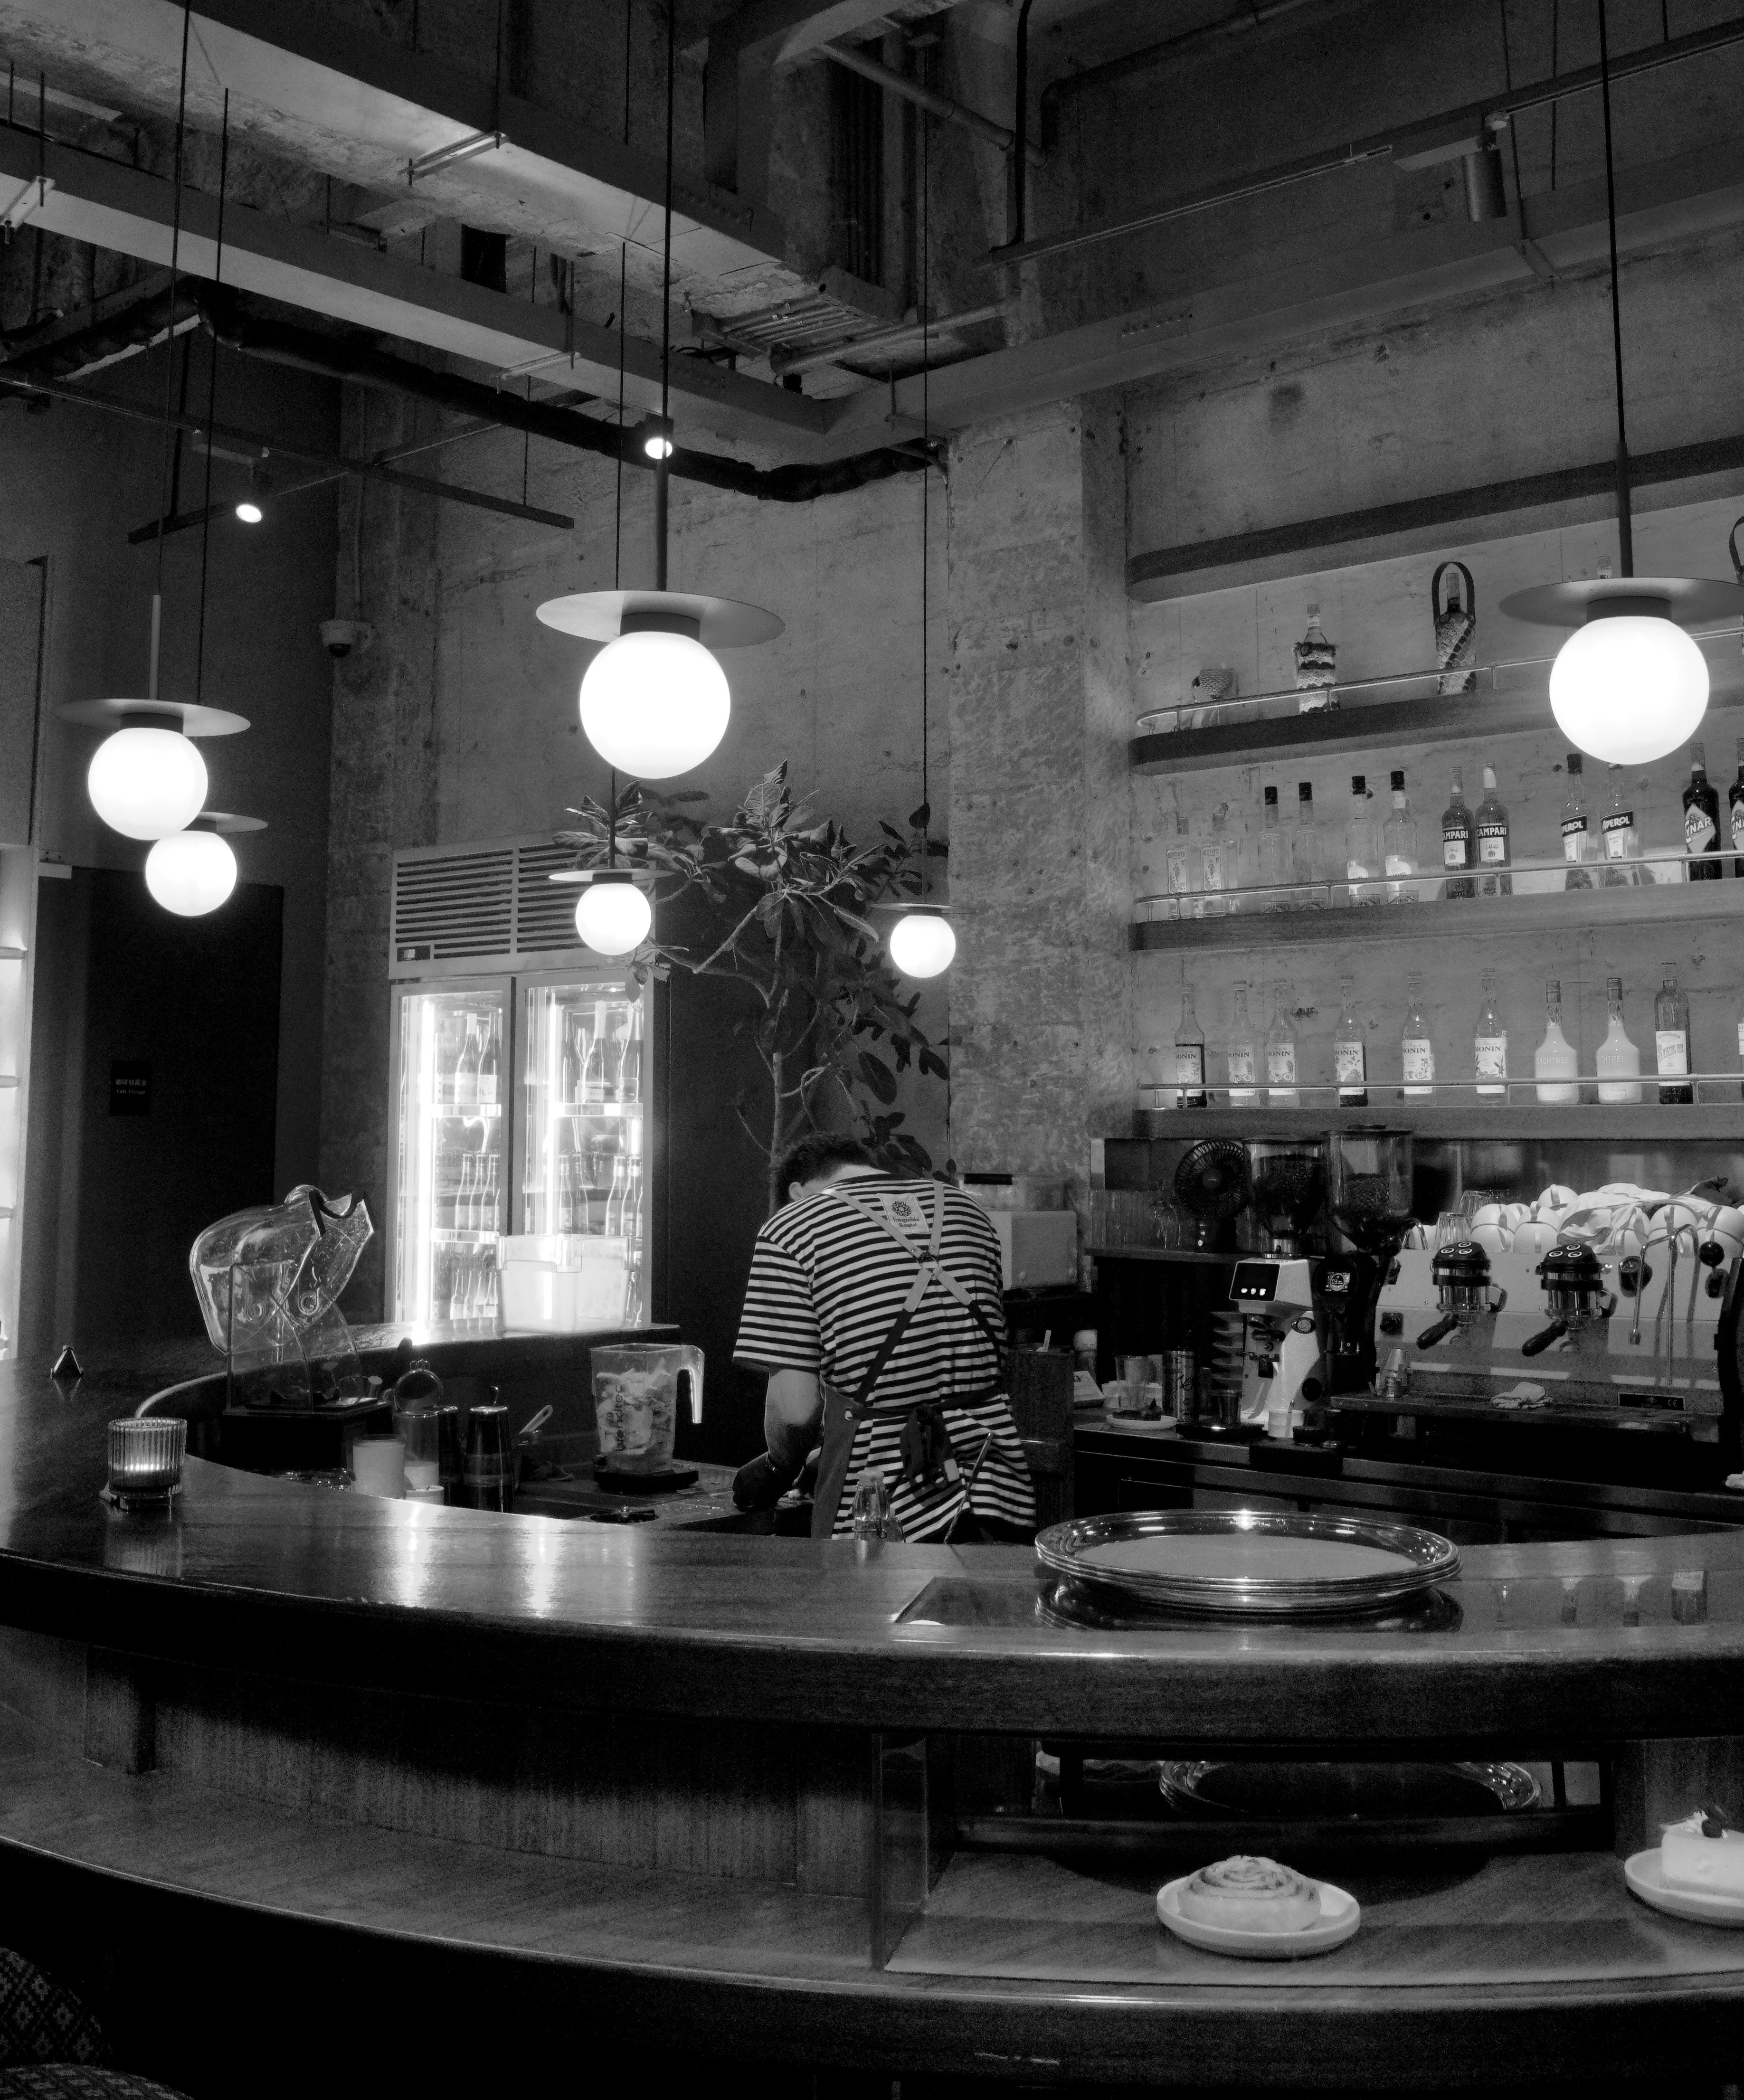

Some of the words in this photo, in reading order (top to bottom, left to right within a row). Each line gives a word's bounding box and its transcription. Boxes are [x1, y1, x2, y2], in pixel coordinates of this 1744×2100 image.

[1477, 827, 1507, 837] CAMPARI
[1602, 816, 1630, 832] APEROL
[1685, 816, 1712, 843] CYNAR
[1731, 815, 1744, 840] CYN
[1203, 848, 1220, 856] BEEFEATER
